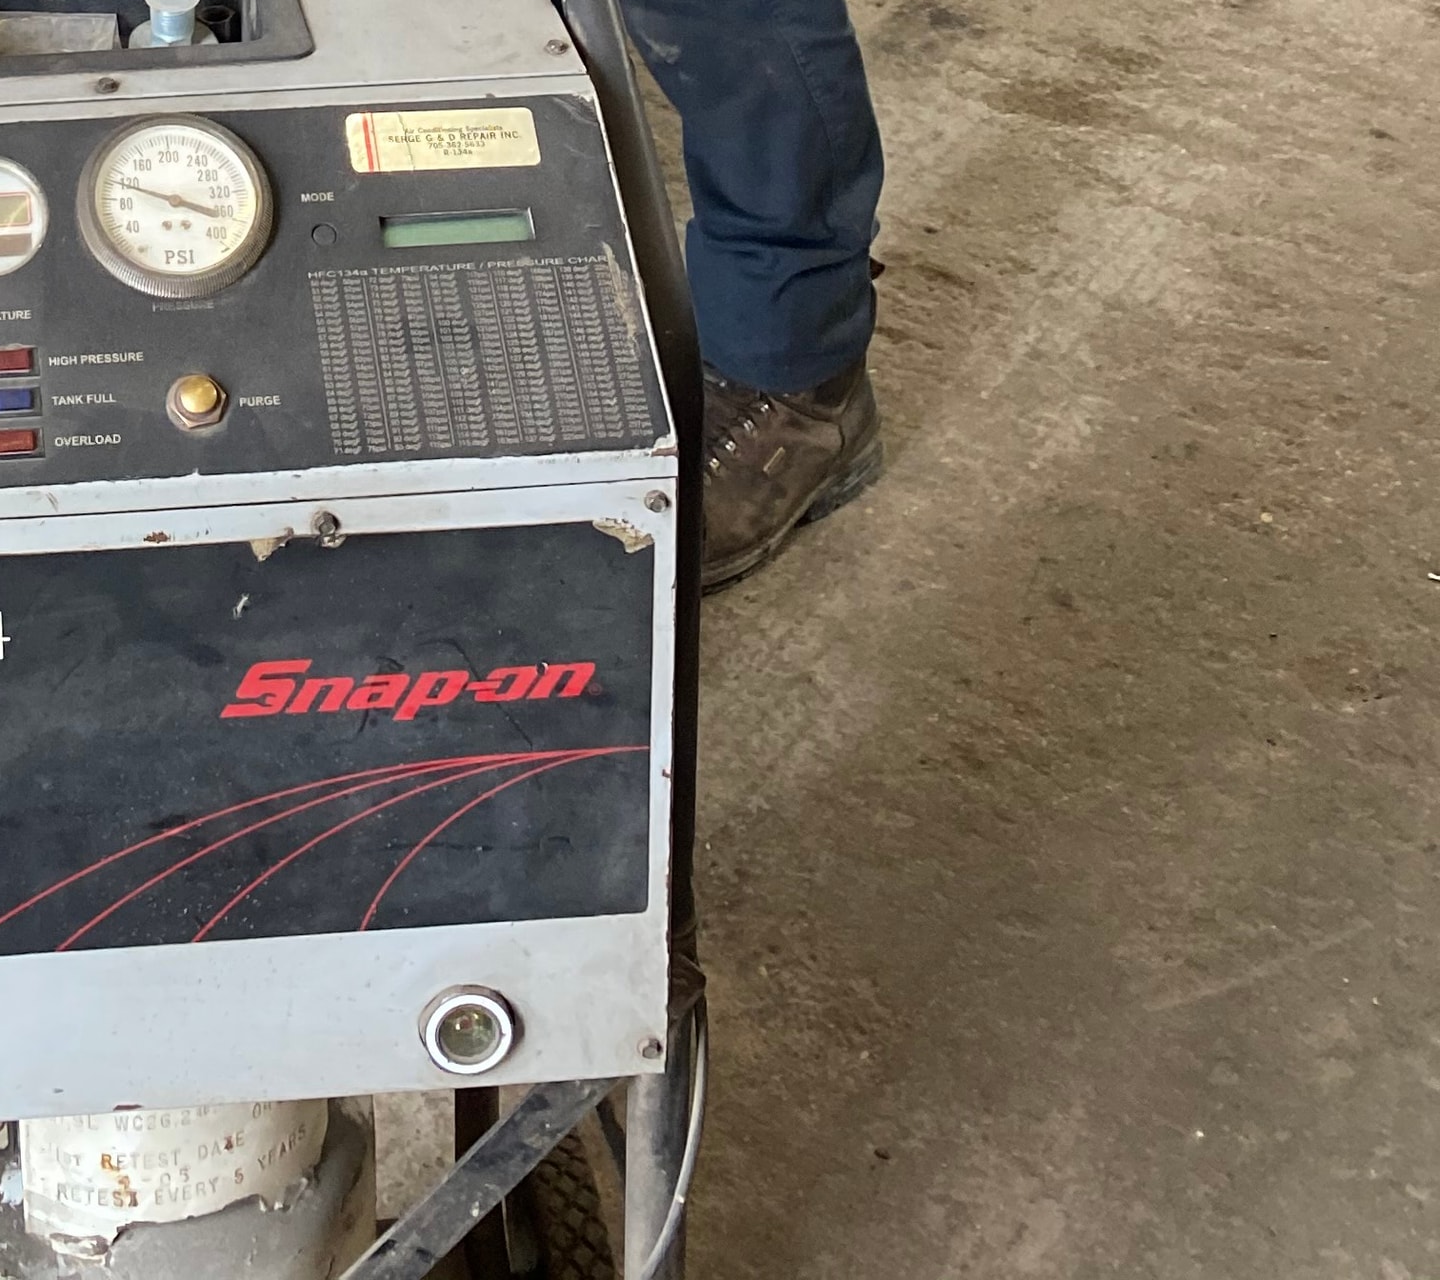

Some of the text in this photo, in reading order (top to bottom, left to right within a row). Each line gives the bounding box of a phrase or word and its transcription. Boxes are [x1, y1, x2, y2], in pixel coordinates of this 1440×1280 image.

[426, 133, 433, 142] G
[449, 132, 456, 141] D
[460, 132, 496, 140] REPAIR
[158, 151, 179, 163] 200
[187, 155, 208, 167] 240
[134, 159, 152, 171] 160
[197, 170, 218, 181] 280
[120, 177, 139, 189] 120
[209, 186, 230, 198] 320
[301, 192, 334, 202] MODE
[120, 198, 133, 210] 80
[126, 221, 139, 233] 40
[206, 227, 227, 239] 400
[165, 250, 195, 264] PSI
[371, 262, 476, 275] TEMPERATURE
[567, 255, 612, 264] CHAR
[49, 352, 144, 366] HIGH PRESSURE
[52, 393, 116, 405] TANK FULL
[239, 394, 280, 406] PURGE
[55, 434, 121, 447] OVERLOAD
[221, 659, 596, 721] Snap-on
[101, 1149, 181, 1171] RETEST
[57, 1183, 139, 1207] RETEST
[154, 1178, 218, 1206] EVERY
